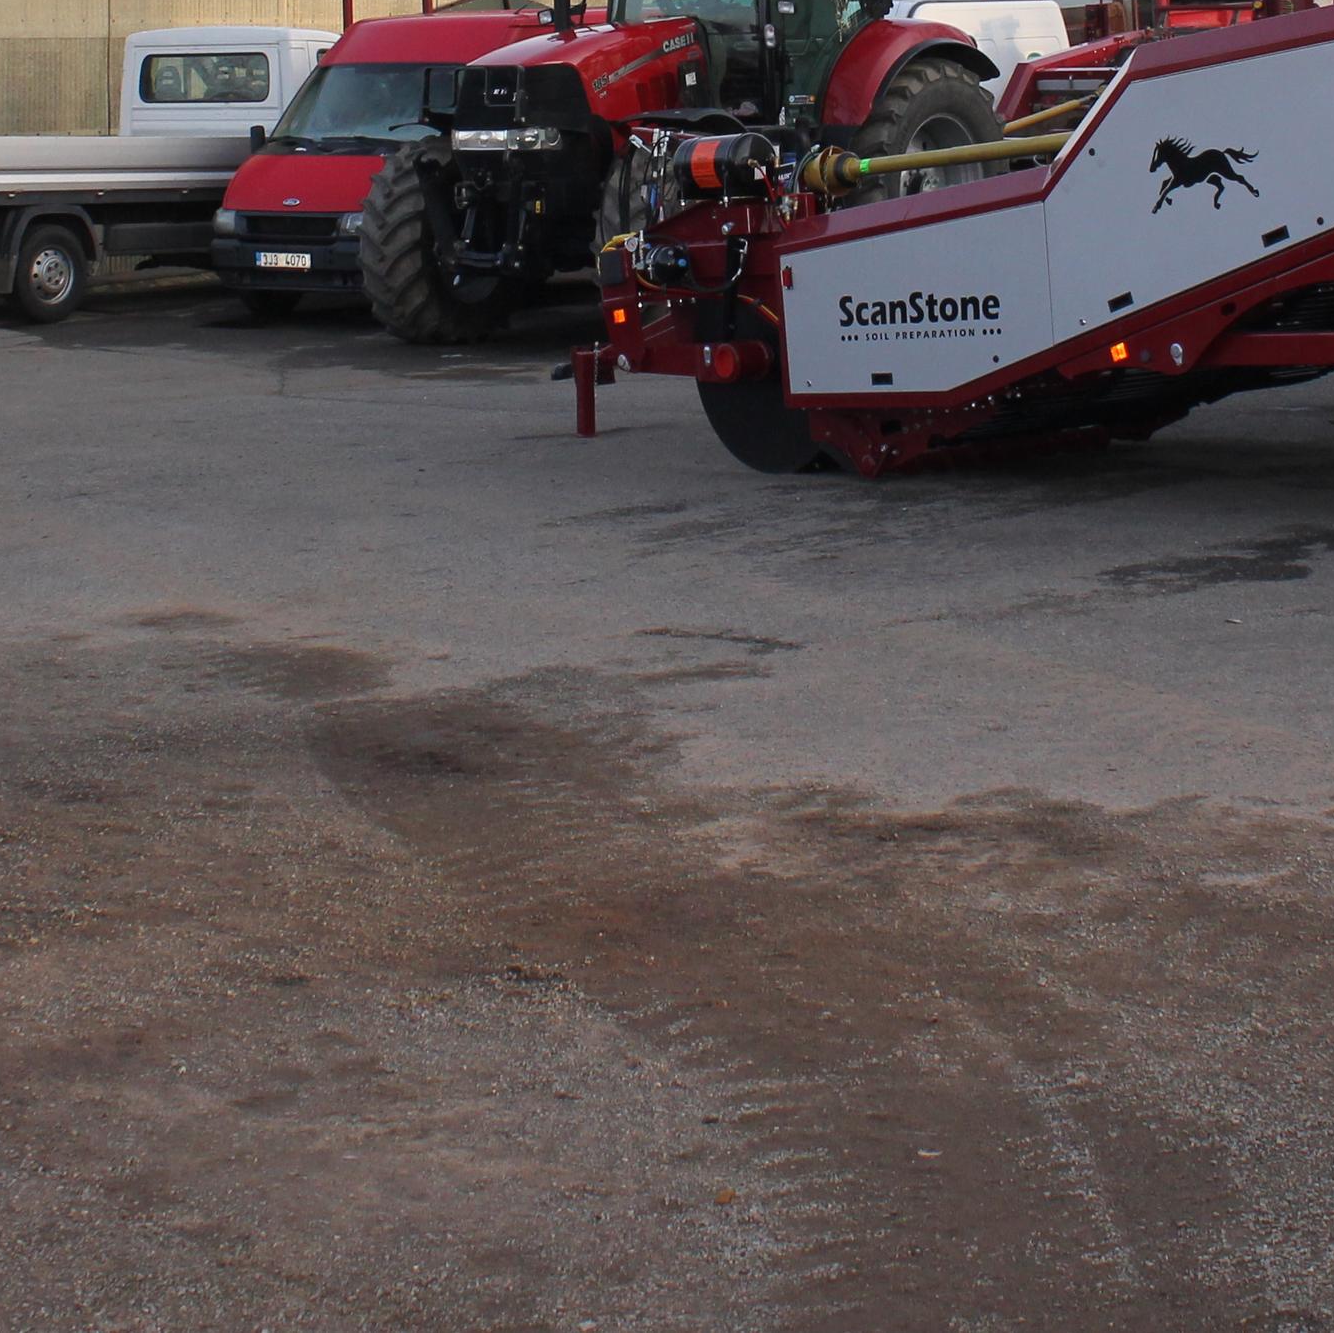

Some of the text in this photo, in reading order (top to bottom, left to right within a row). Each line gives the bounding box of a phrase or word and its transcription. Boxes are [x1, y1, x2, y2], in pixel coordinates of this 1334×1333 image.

[662, 35, 686, 53] CASE
[285, 254, 307, 267] 4070
[839, 291, 1001, 327] ScanStone
[865, 328, 976, 341] SOIL PREPARATION
